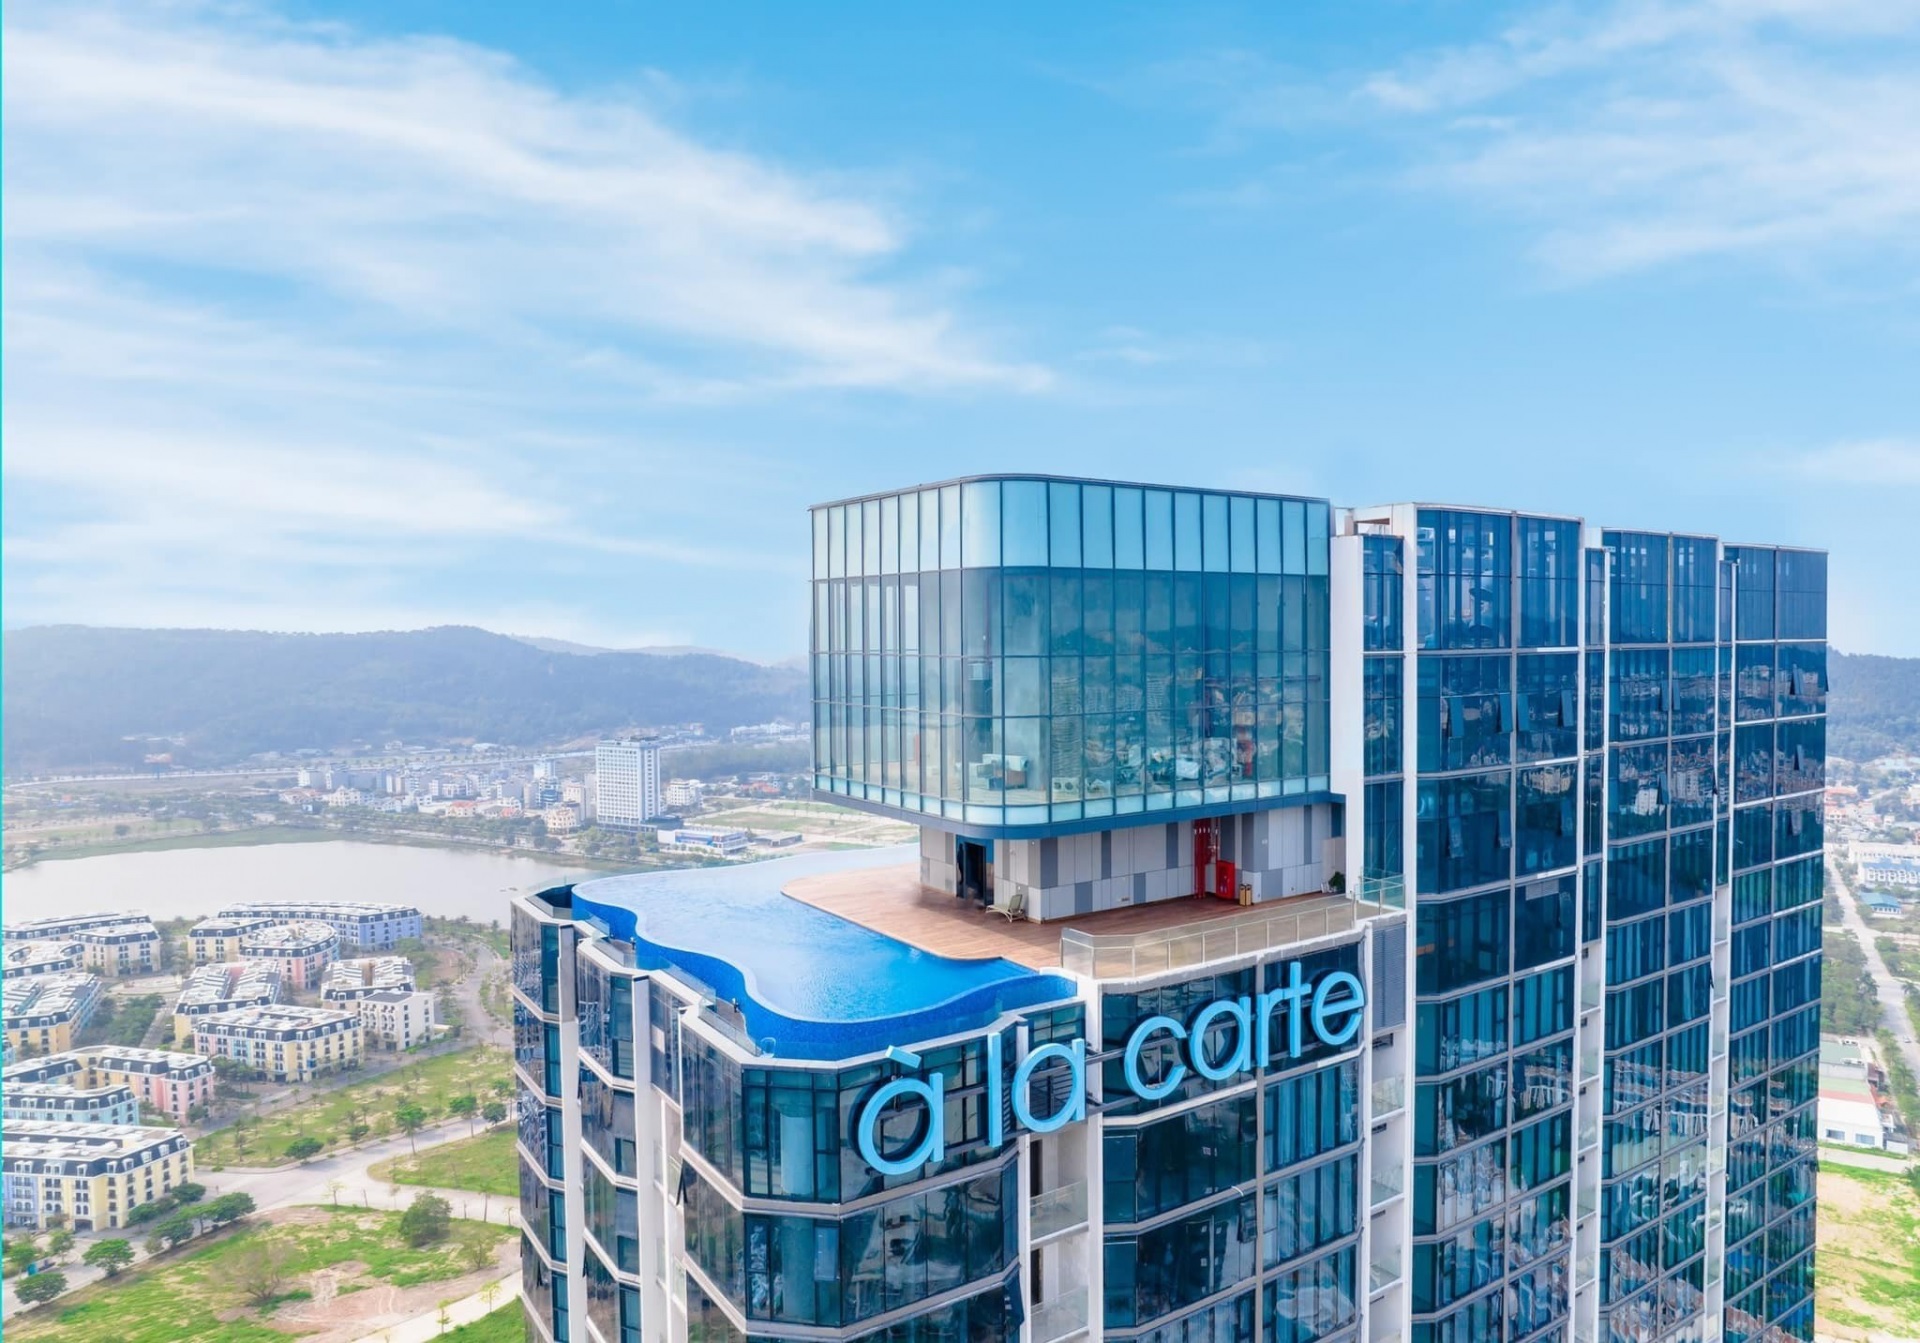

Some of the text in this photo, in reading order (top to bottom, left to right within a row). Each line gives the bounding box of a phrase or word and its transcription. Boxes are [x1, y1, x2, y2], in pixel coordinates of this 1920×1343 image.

[857, 962, 1365, 1175] à la carte
